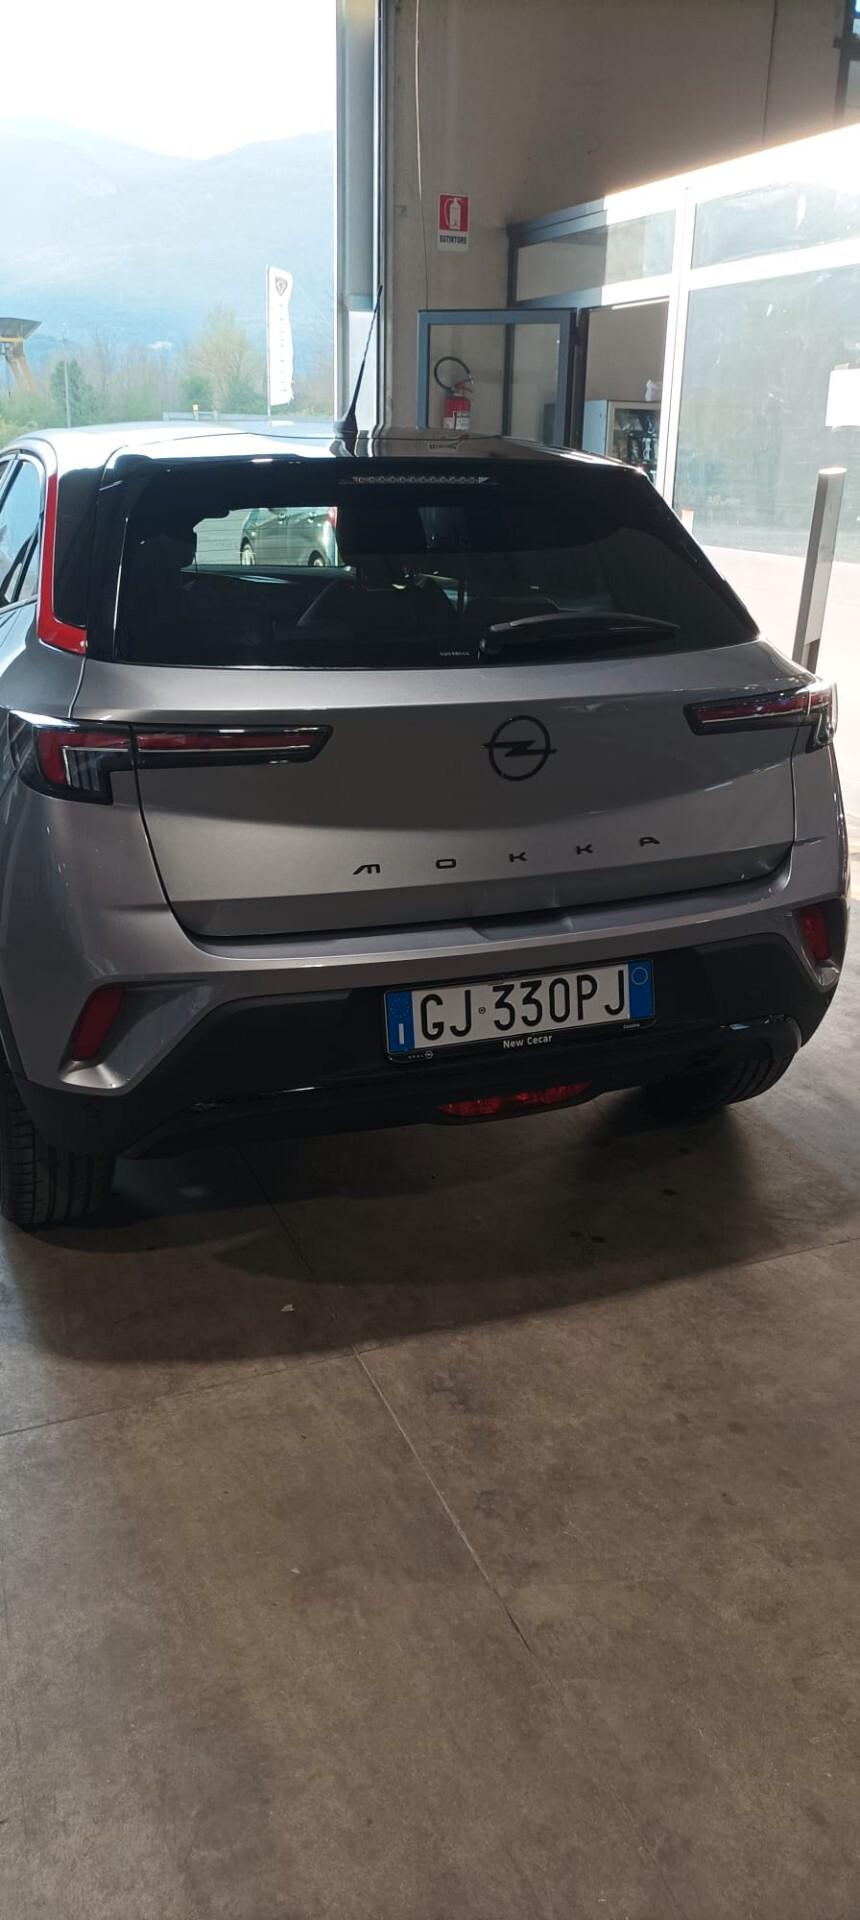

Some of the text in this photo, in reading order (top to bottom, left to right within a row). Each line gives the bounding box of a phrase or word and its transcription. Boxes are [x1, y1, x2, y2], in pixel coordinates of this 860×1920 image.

[353, 836, 661, 875] MOKKA
[420, 969, 626, 1041] GJ 330PJ
[502, 1034, 553, 1049] New Cecar
